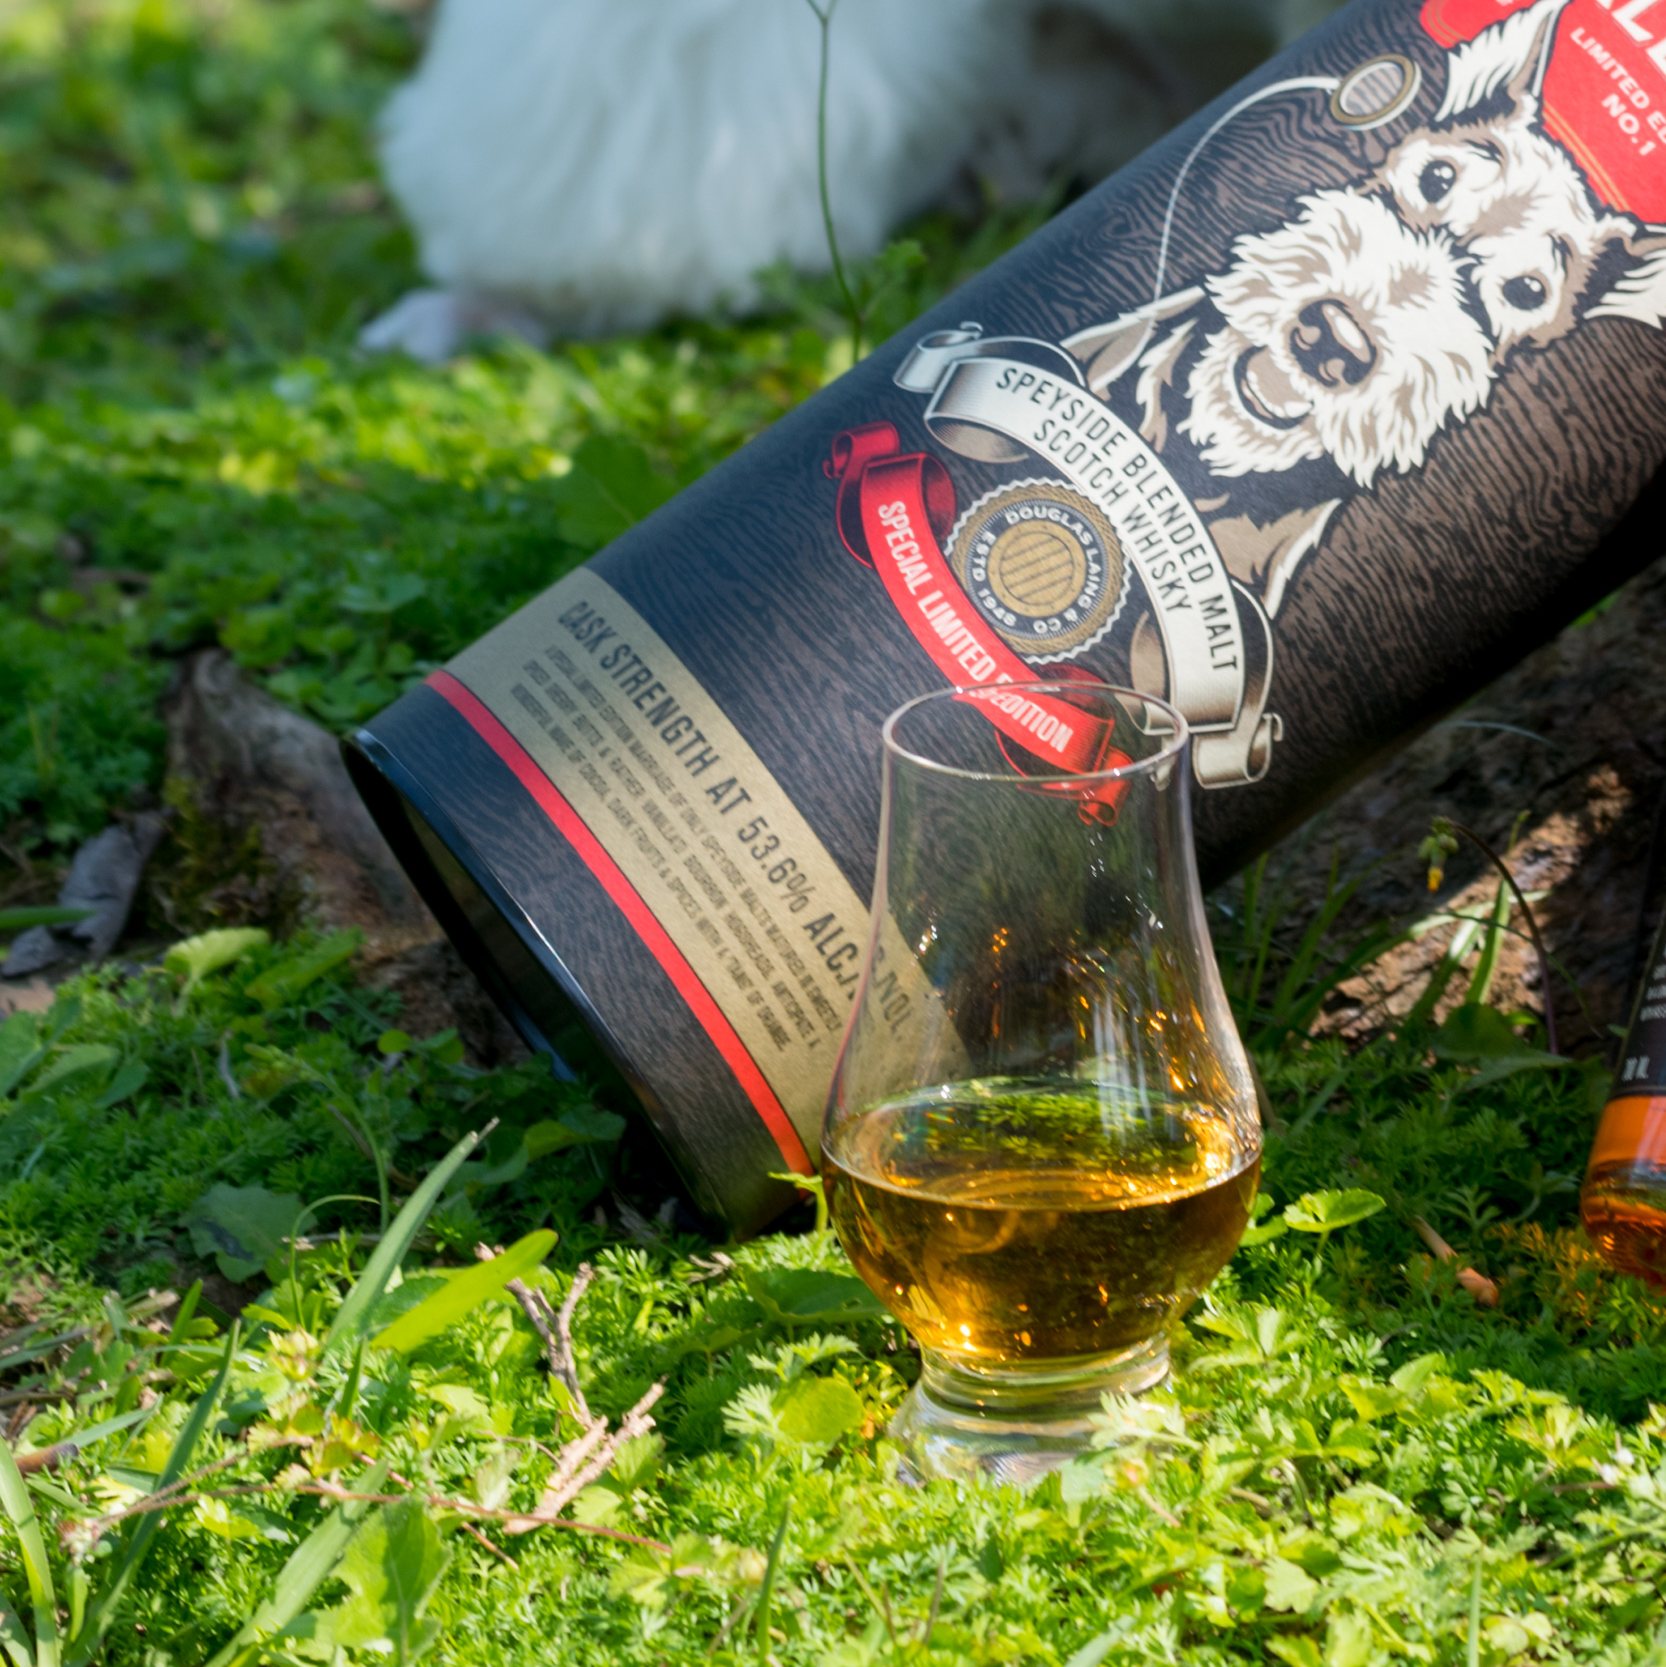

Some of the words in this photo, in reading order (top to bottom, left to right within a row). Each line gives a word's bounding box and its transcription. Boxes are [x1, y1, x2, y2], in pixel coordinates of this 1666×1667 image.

[1570, 27, 1650, 110] LIMITED
[995, 367, 1129, 457] SPEYSIDE
[1121, 453, 1216, 584] BLENDED
[1198, 593, 1239, 672] MALT
[1005, 505, 1094, 546] DOUGLAS
[1033, 419, 1130, 509] SCOTCH
[1120, 503, 1193, 613] WHISKY
[1076, 547, 1102, 609] LAING
[878, 500, 933, 596] SPECIAL
[916, 589, 997, 683] LIMITED
[1033, 617, 1061, 635] CO
[558, 600, 617, 655] CASK
[601, 643, 720, 779] STRENGTH
[705, 775, 753, 816] AT
[737, 814, 817, 914] 53.6%
